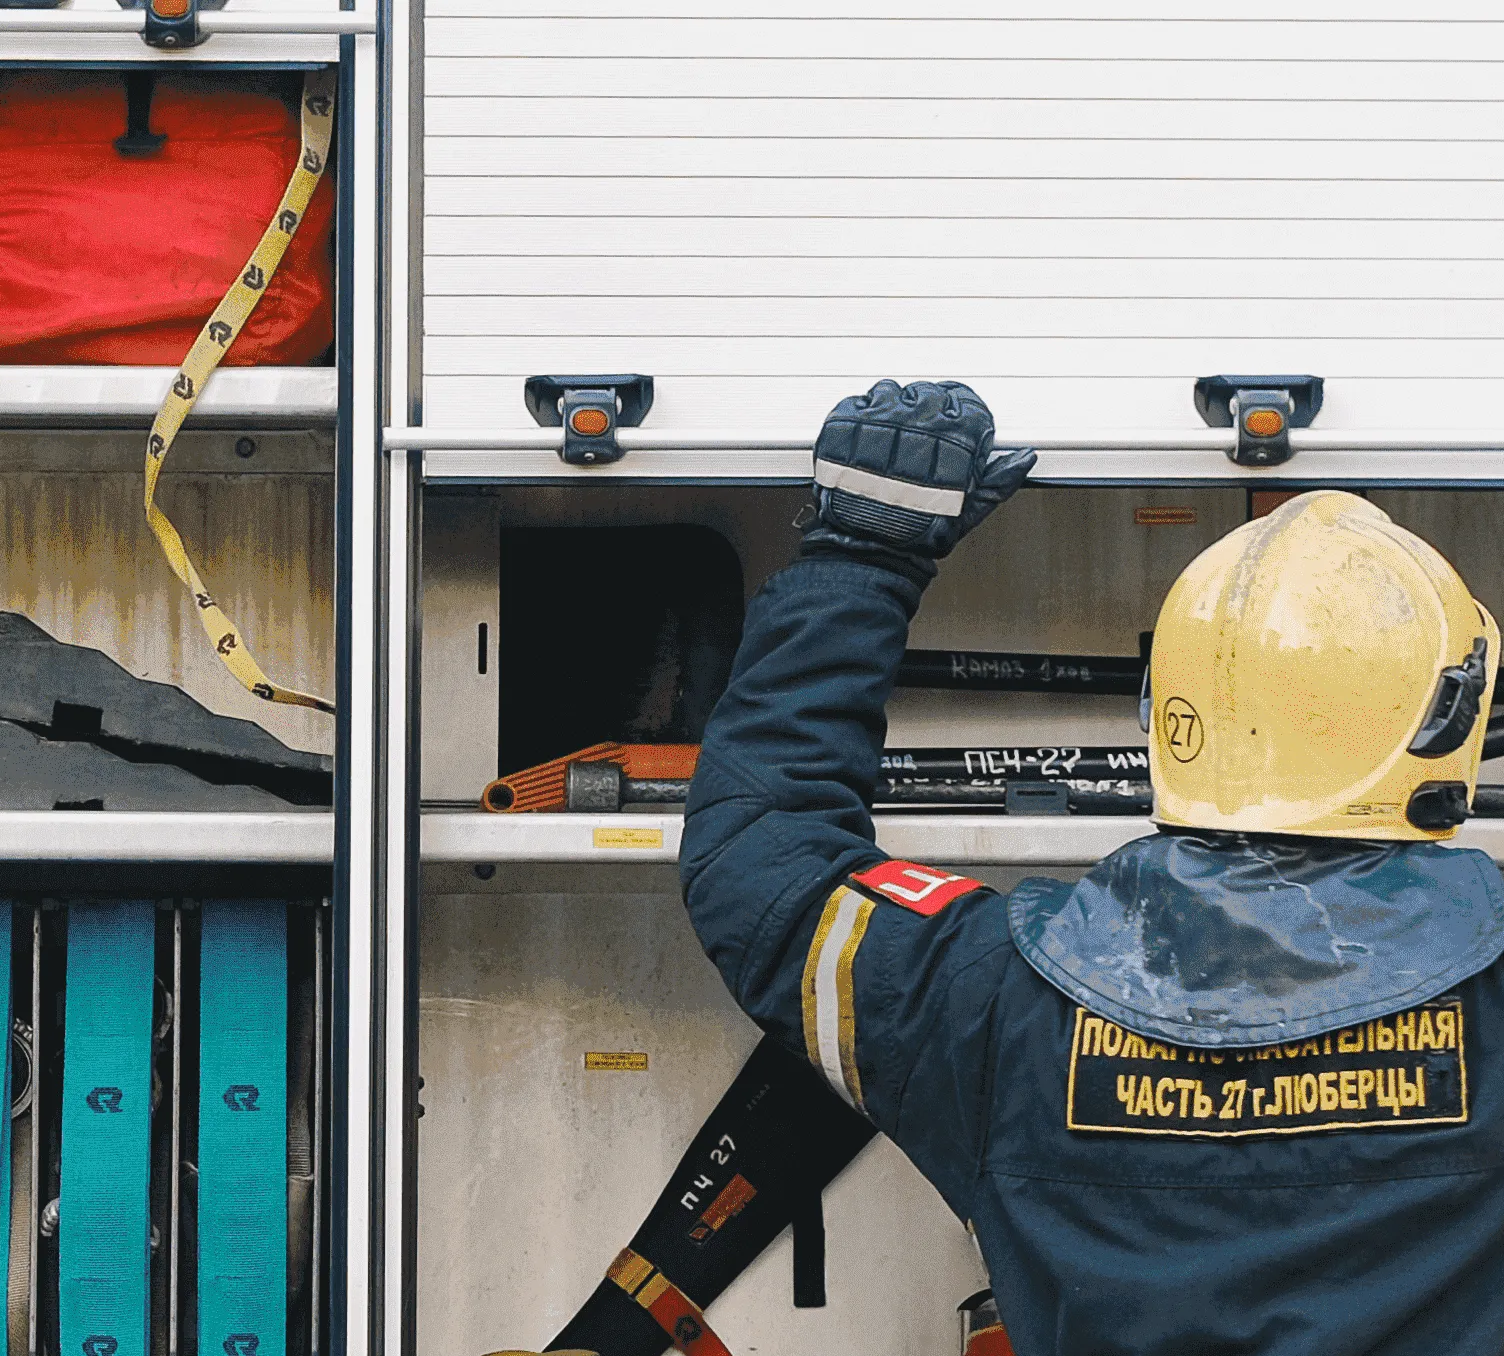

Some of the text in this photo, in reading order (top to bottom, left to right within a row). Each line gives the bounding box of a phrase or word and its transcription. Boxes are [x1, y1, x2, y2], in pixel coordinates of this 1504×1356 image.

[1168, 711, 1197, 748] 27
[1116, 1073, 1213, 1120] ЧАСТЬ
[1218, 1078, 1248, 1120] 27
[709, 1133, 737, 1166] 27
